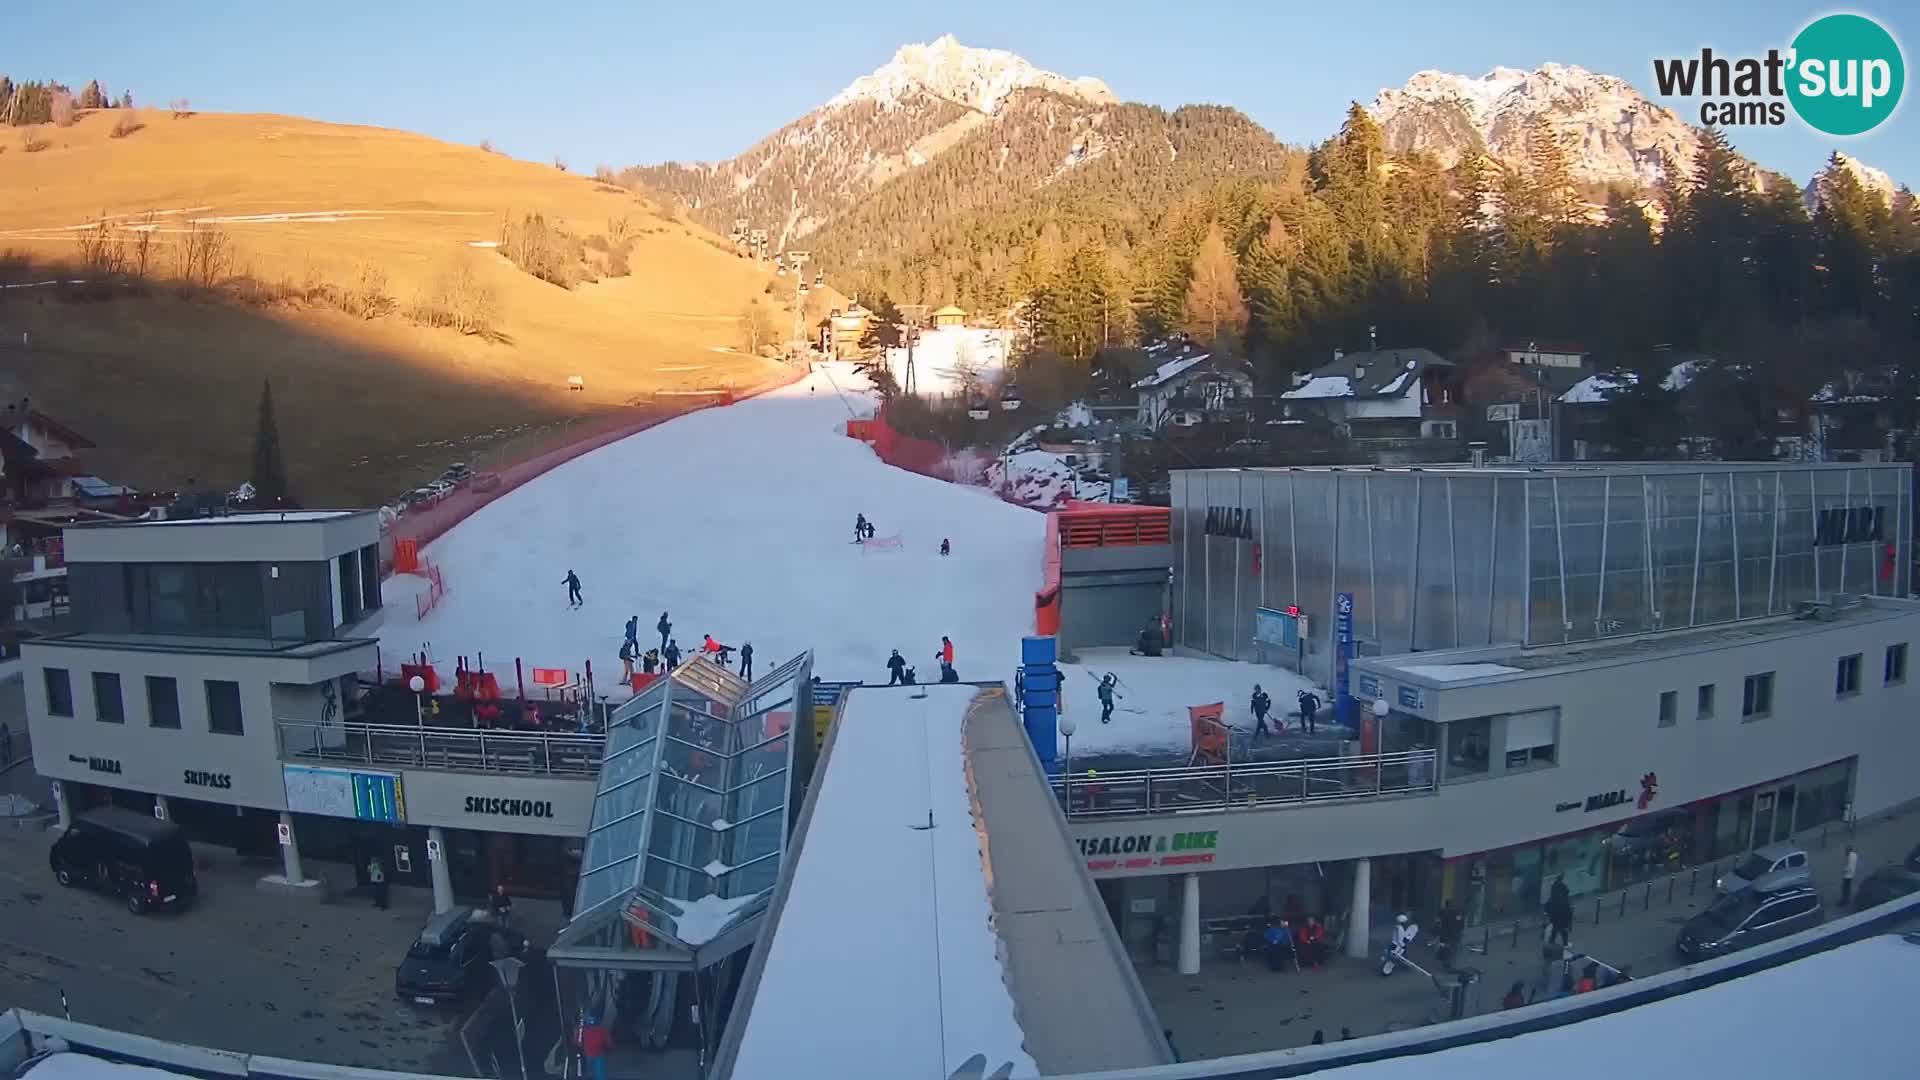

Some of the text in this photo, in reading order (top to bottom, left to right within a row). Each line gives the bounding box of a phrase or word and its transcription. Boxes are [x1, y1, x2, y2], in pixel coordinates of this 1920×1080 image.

[184, 769, 232, 790] SKIPASS
[464, 795, 554, 819] SKISCHOOL
[1172, 830, 1219, 851] BIKE
